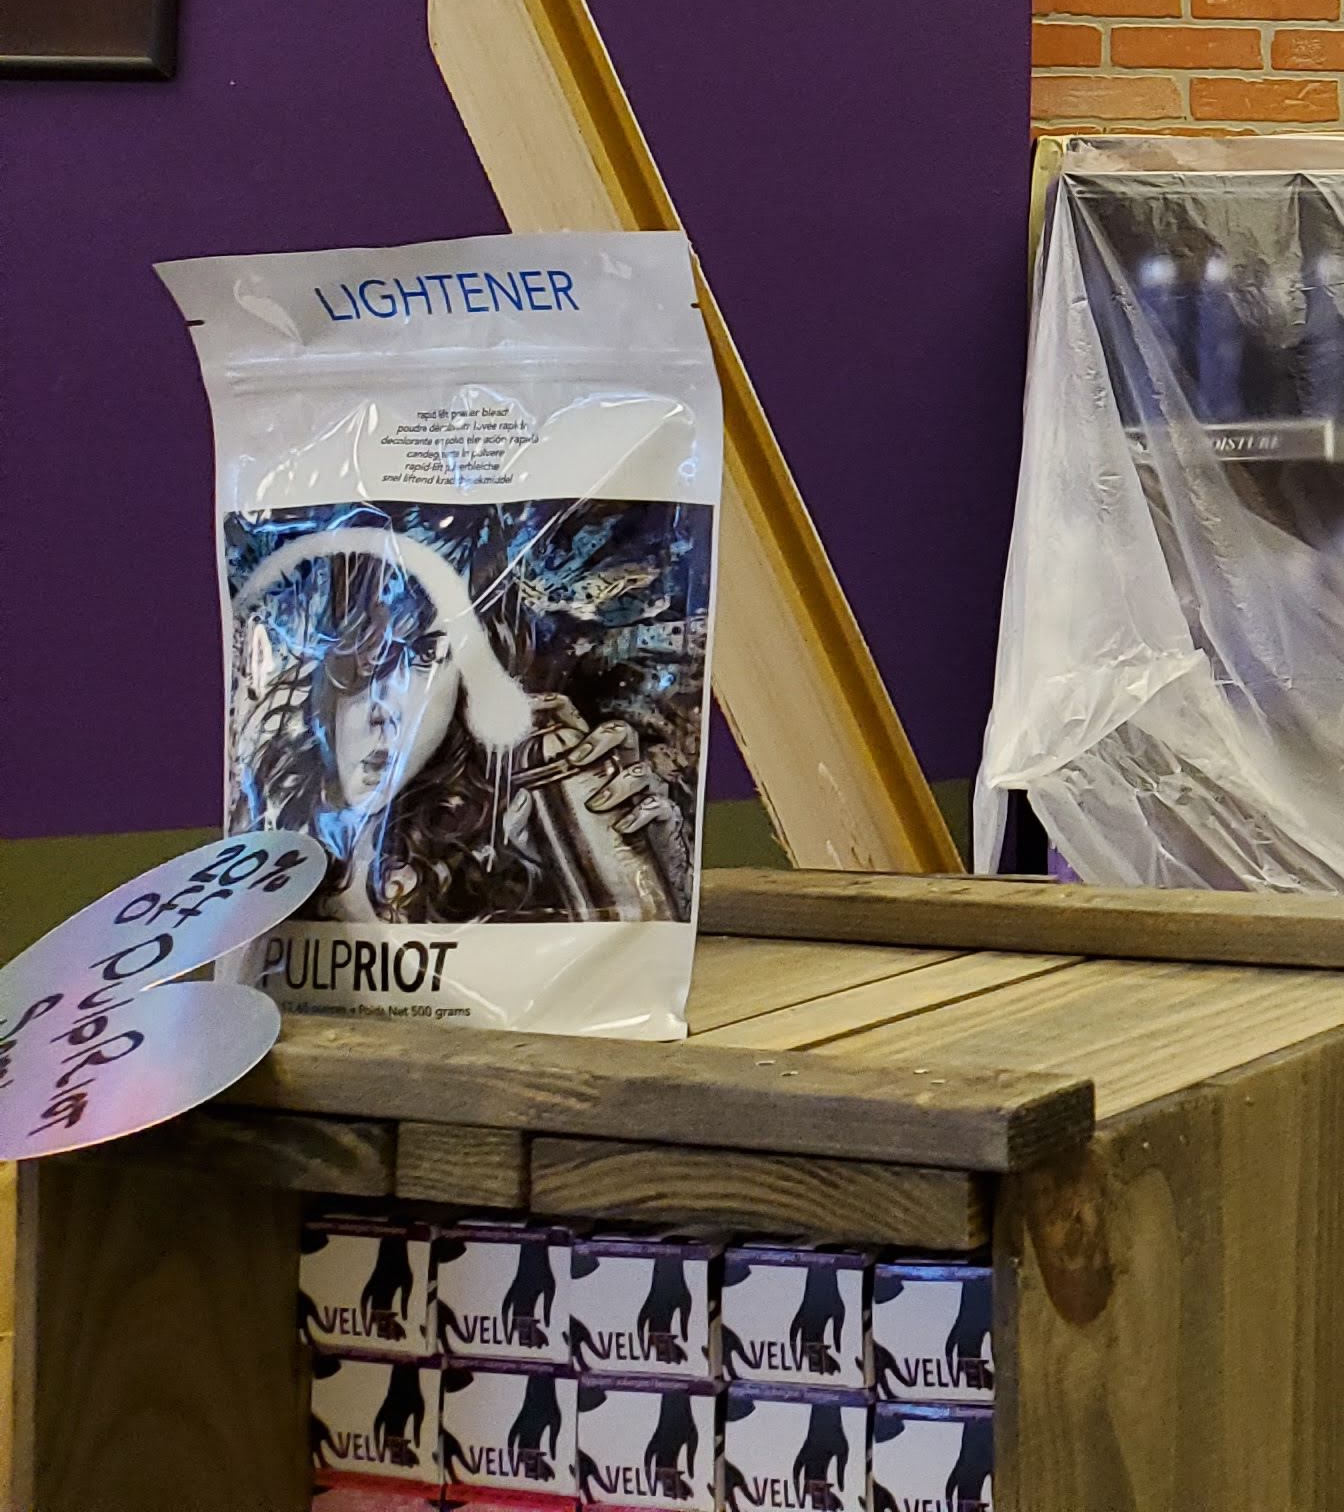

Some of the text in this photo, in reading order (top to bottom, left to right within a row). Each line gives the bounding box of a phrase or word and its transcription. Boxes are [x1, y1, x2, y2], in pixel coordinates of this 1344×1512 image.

[314, 269, 581, 322] LIGHTENER
[188, 843, 309, 893] 20%
[262, 937, 459, 993] PULPRIOT
[411, 1004, 432, 1017] 500
[435, 1006, 471, 1020] grams
